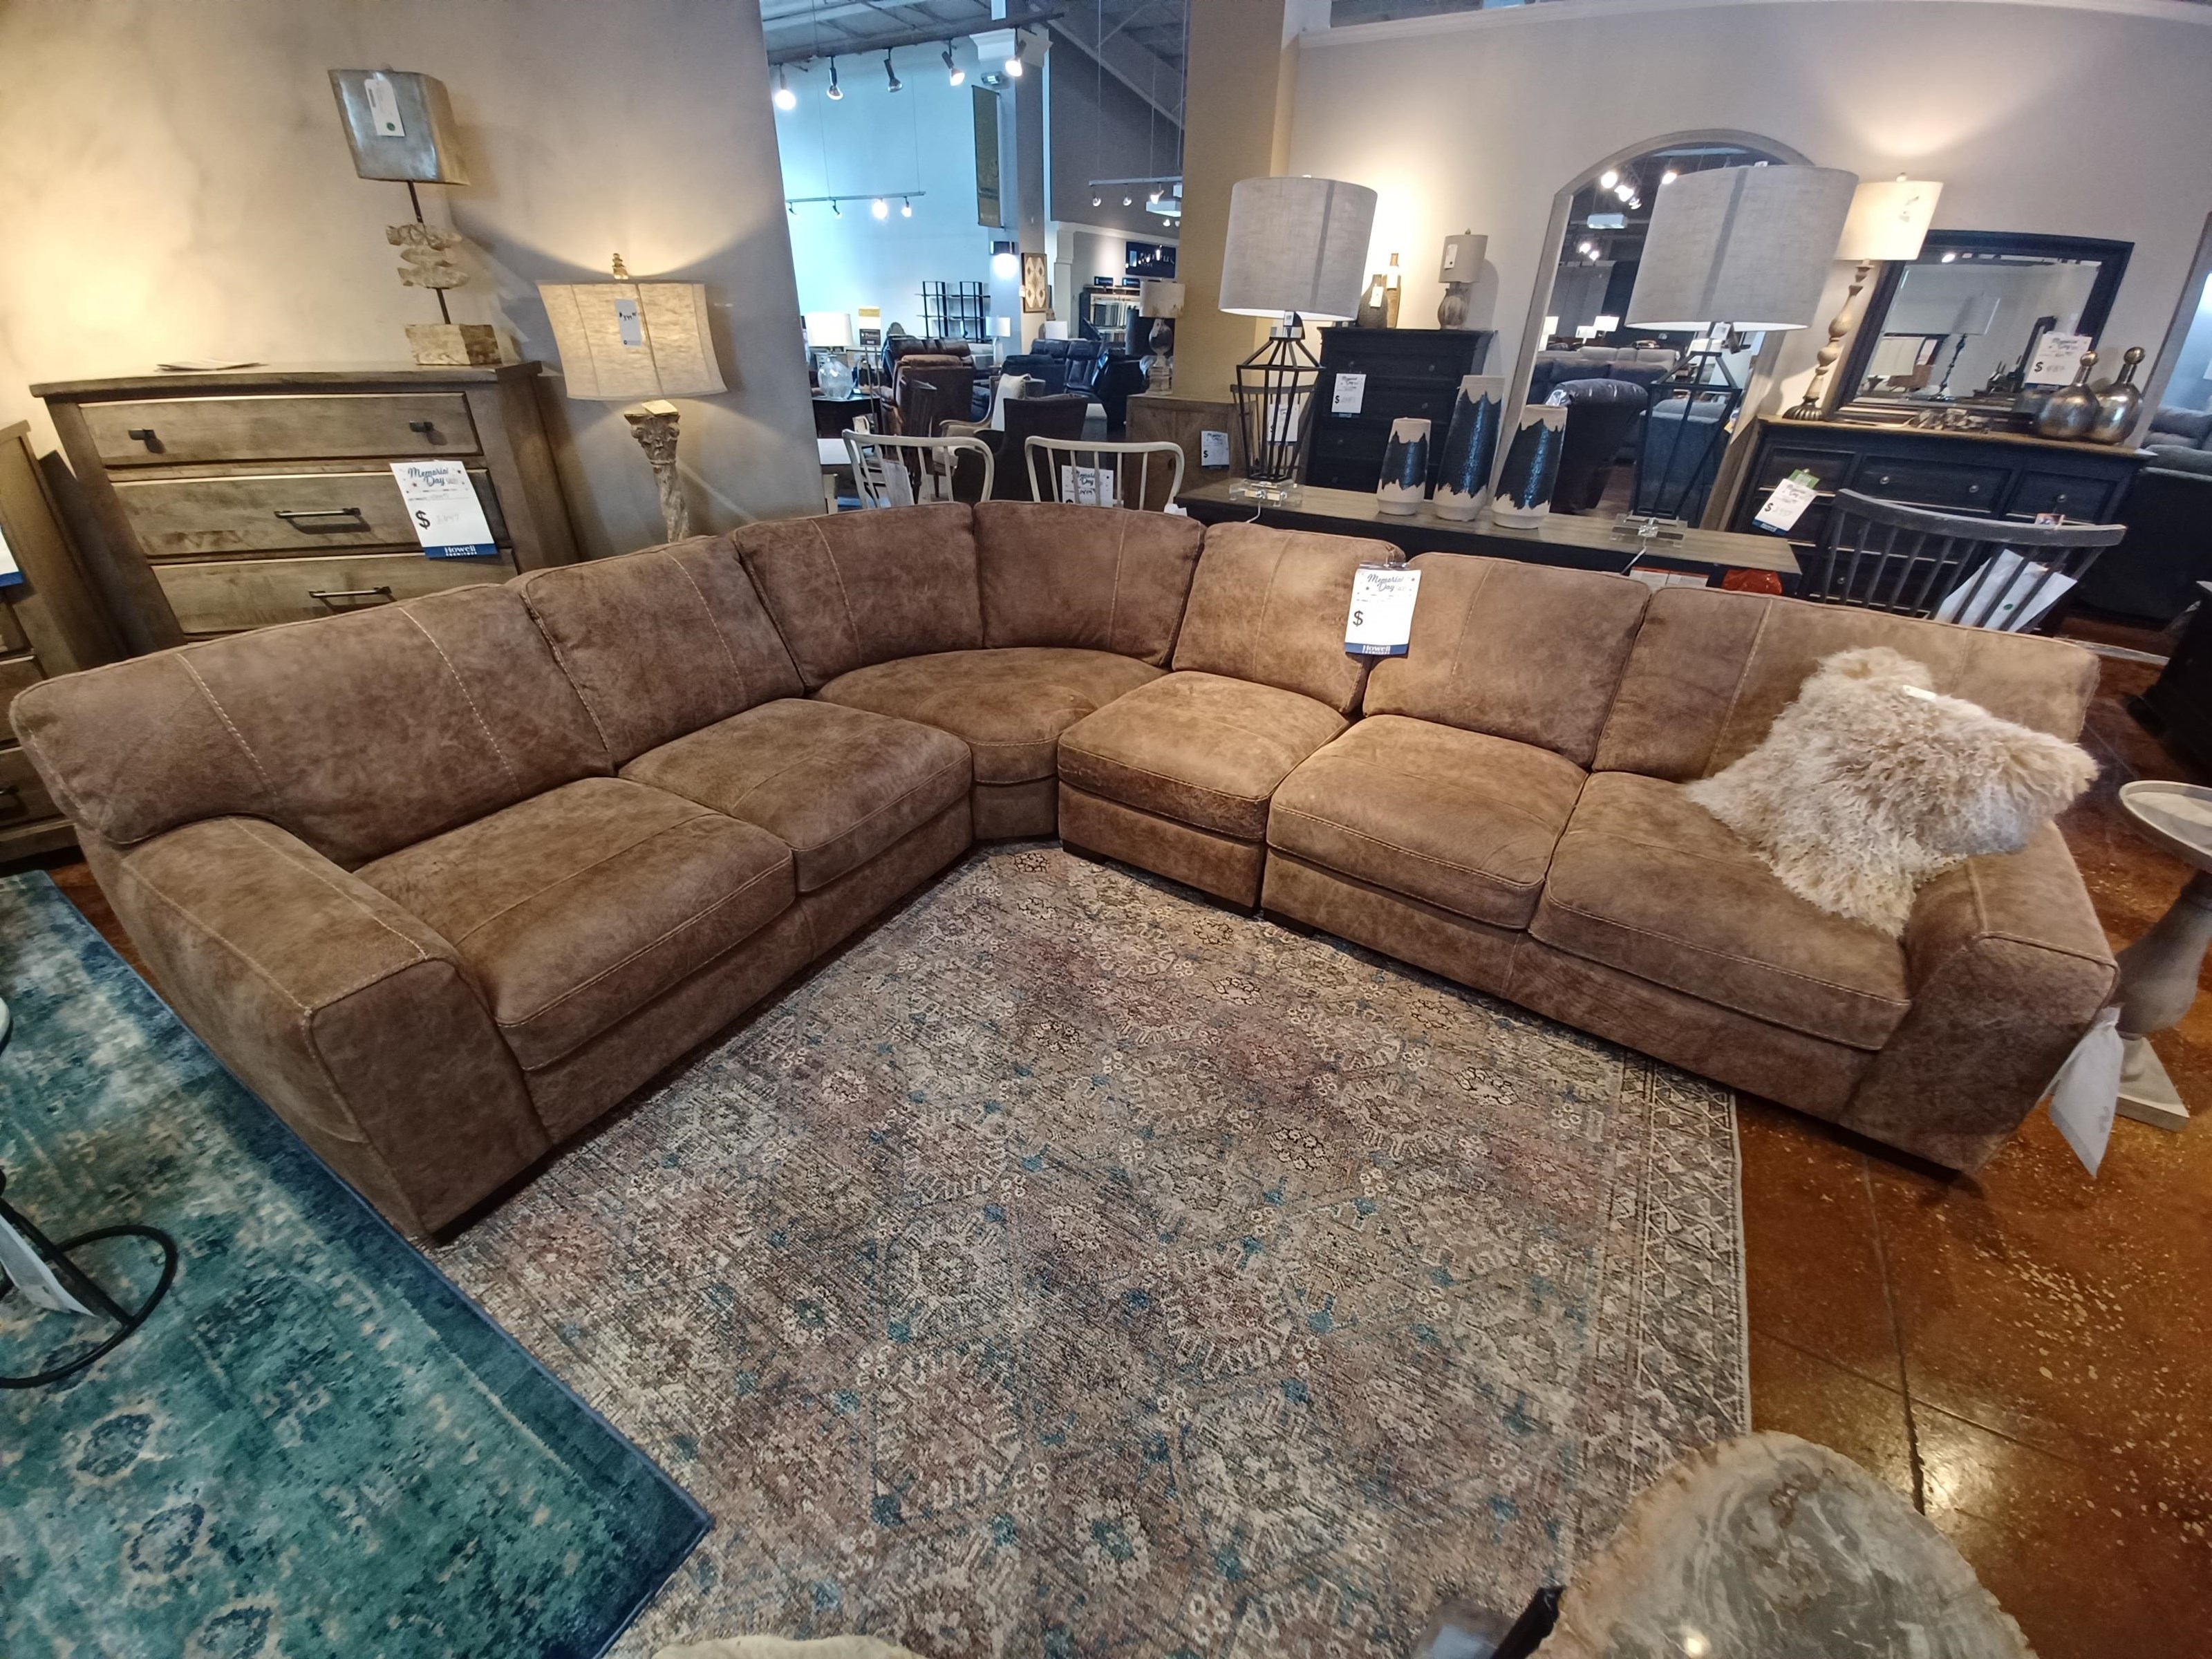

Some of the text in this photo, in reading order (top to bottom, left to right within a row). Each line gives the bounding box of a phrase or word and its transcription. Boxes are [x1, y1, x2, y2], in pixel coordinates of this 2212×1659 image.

[408, 467, 449, 478] Memorial
[424, 476, 445, 487] Day
[415, 510, 431, 529] $
[444, 545, 477, 554] Howell
[1367, 574, 1405, 583] Memorial
[1376, 583, 1395, 592] Day
[1352, 610, 1364, 627] $
